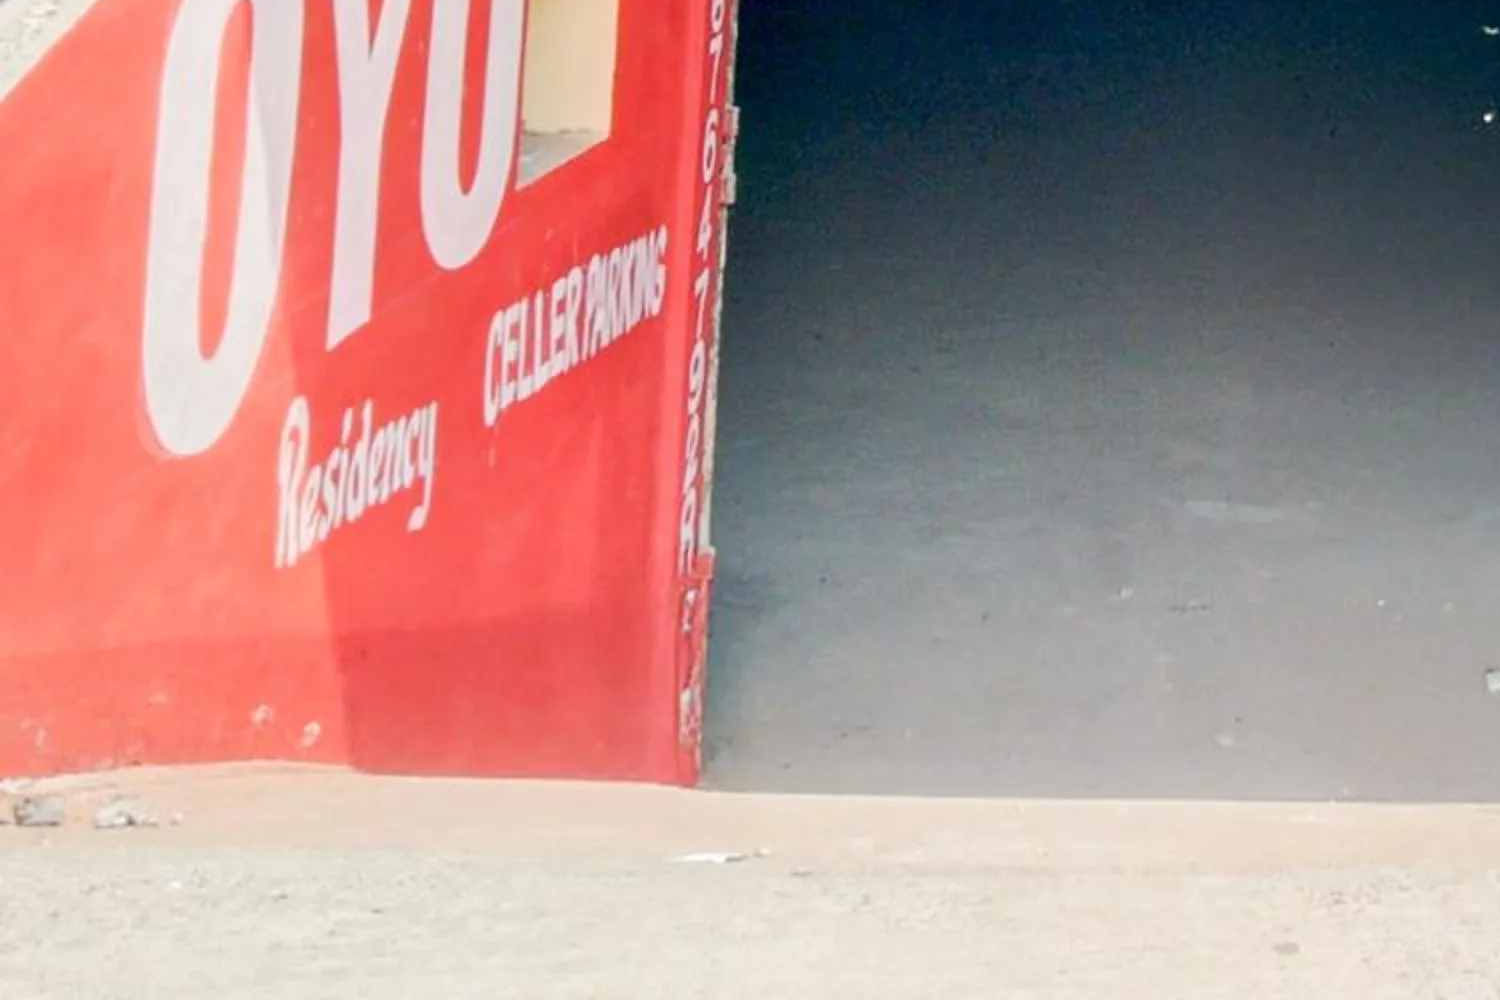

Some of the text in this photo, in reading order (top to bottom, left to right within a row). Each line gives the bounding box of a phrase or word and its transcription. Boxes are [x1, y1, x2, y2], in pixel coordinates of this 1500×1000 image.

[484, 224, 669, 428] CELLER PARKING
[274, 395, 438, 570] Residency
